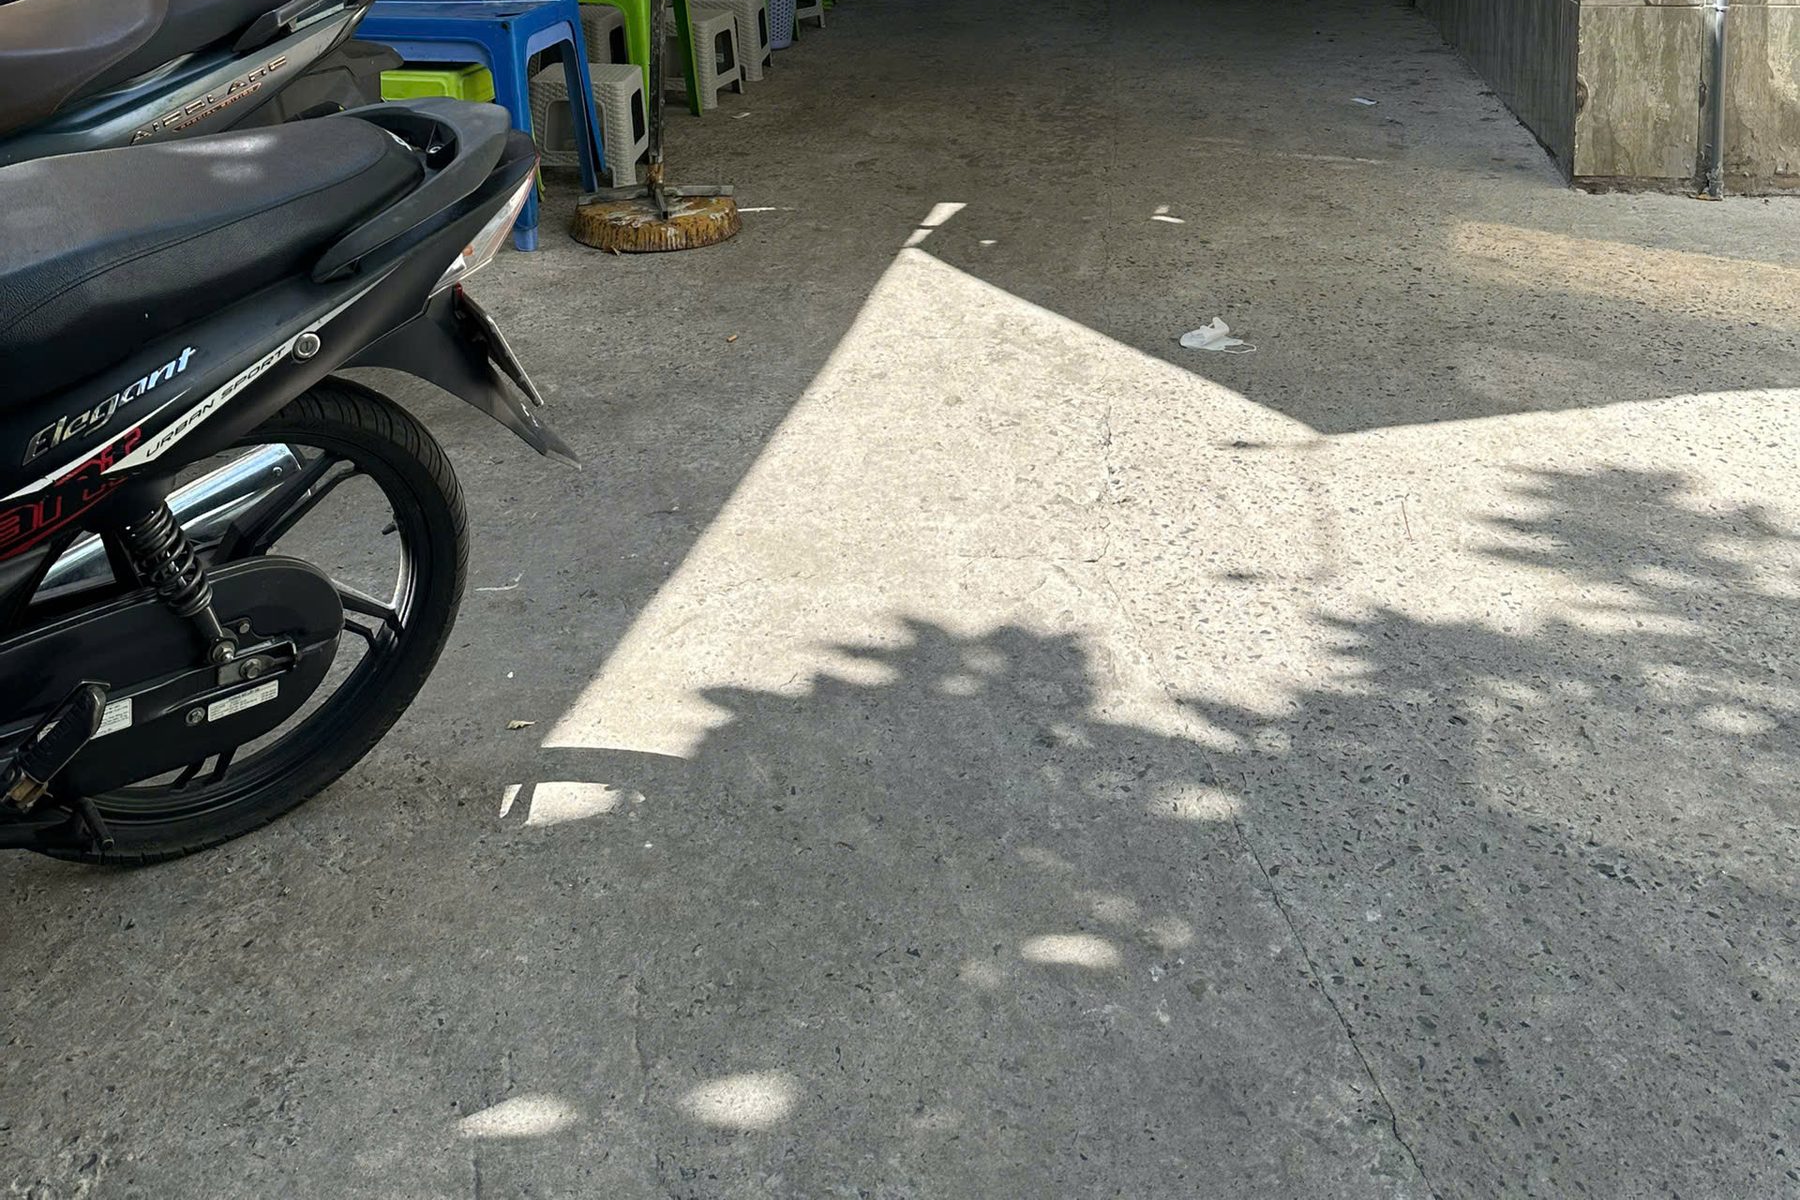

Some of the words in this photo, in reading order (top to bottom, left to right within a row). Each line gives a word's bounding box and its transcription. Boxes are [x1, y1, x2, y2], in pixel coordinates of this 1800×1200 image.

[22, 346, 196, 467] Elegant
[146, 400, 215, 457] URBAN
[221, 346, 287, 400] SPORT
